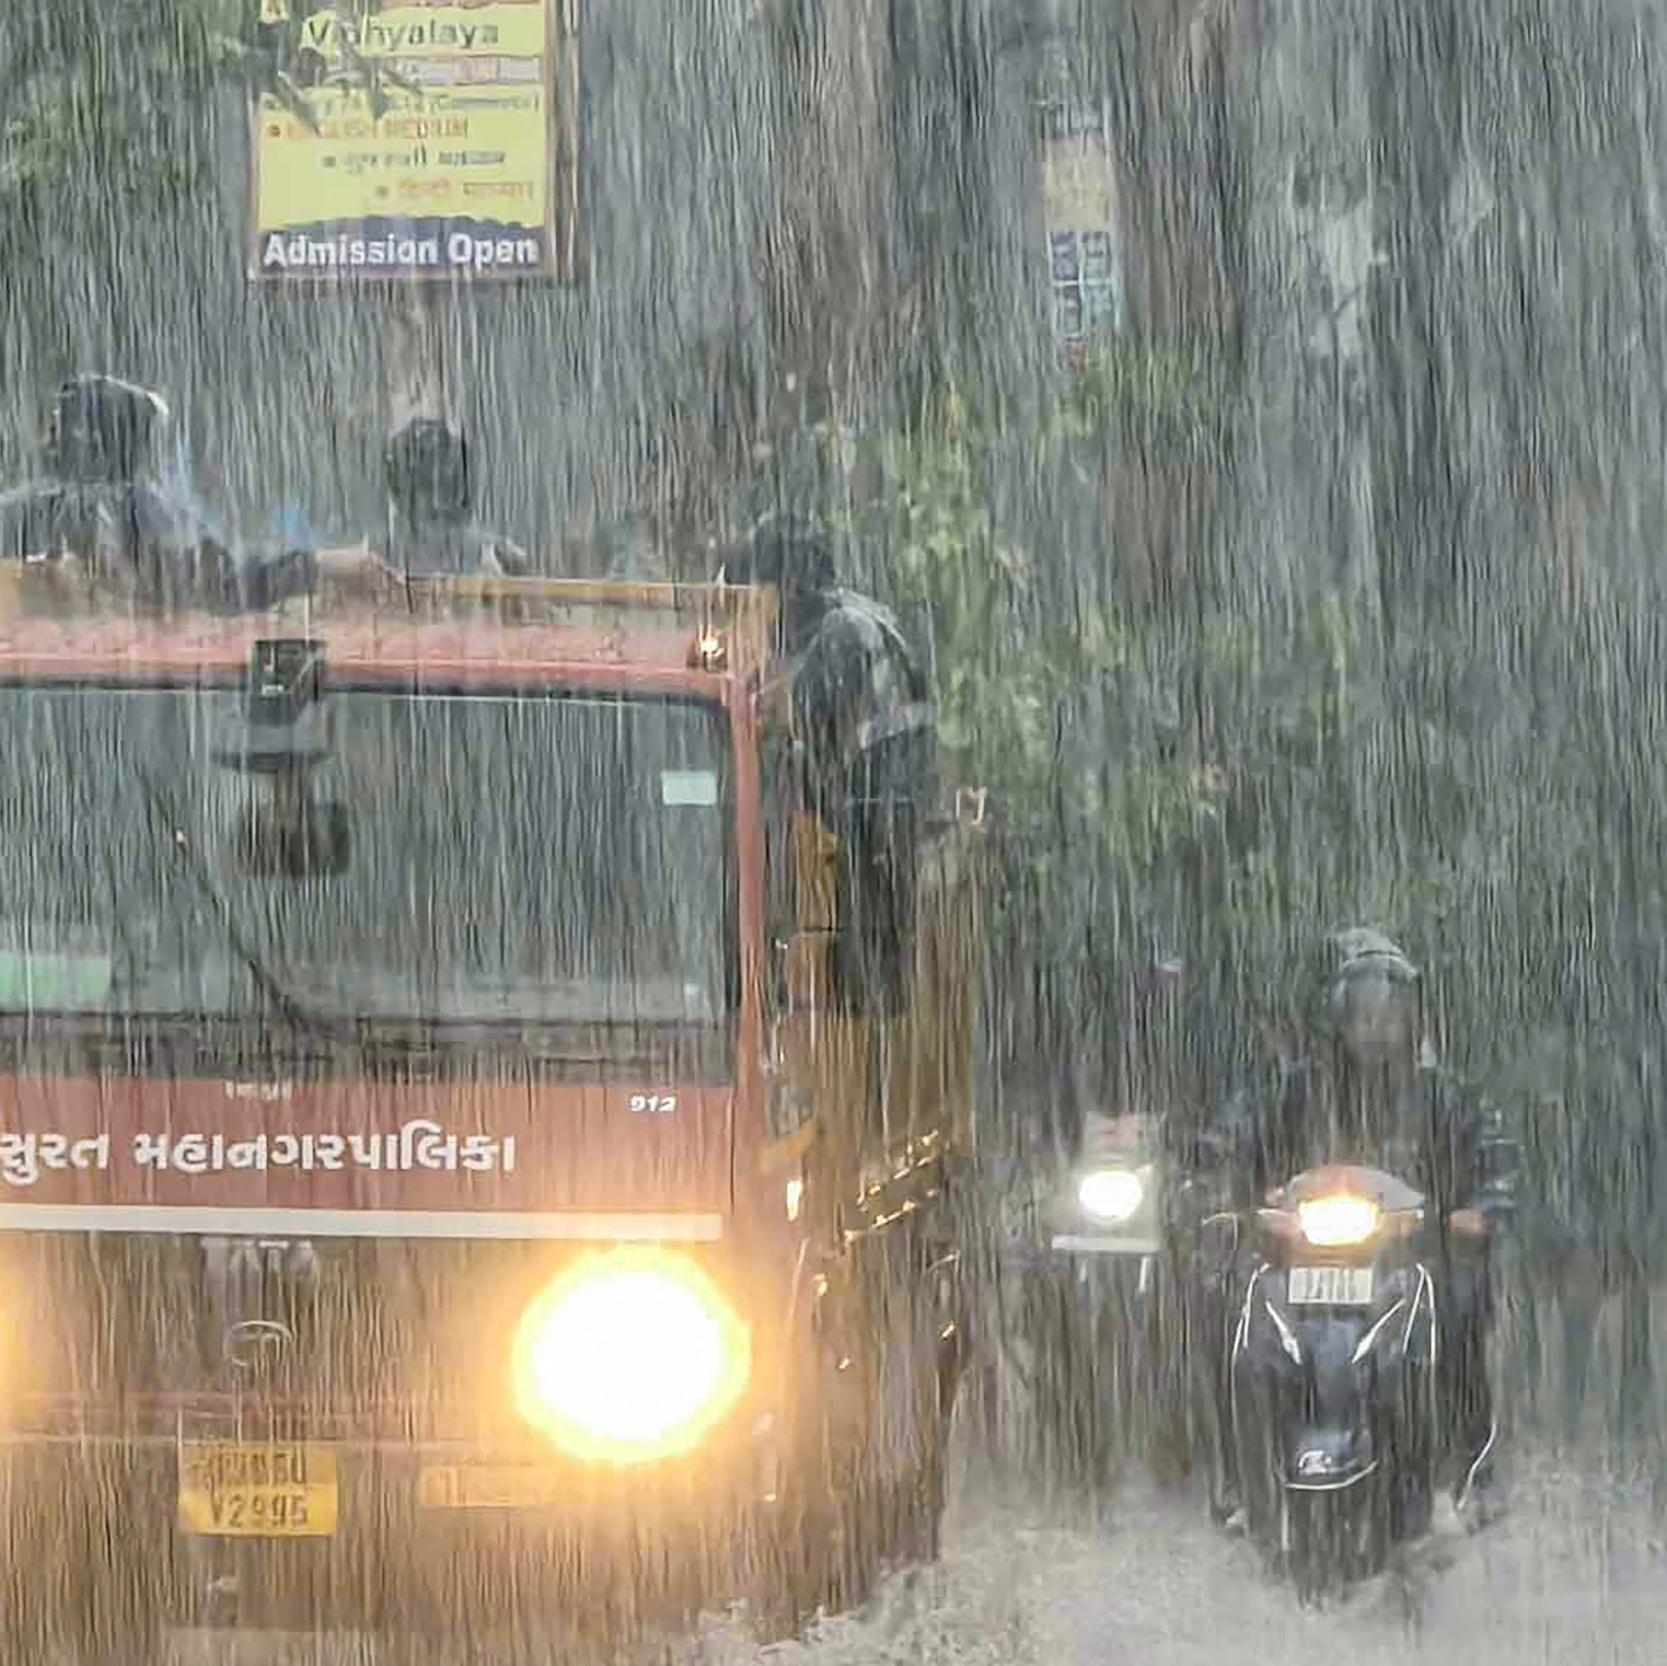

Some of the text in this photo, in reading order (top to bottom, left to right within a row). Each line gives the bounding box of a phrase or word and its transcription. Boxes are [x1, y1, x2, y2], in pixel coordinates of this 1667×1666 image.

[263, 233, 538, 275] Admission Open
[133, 1118, 516, 1173] મહાનગરપાલિકા
